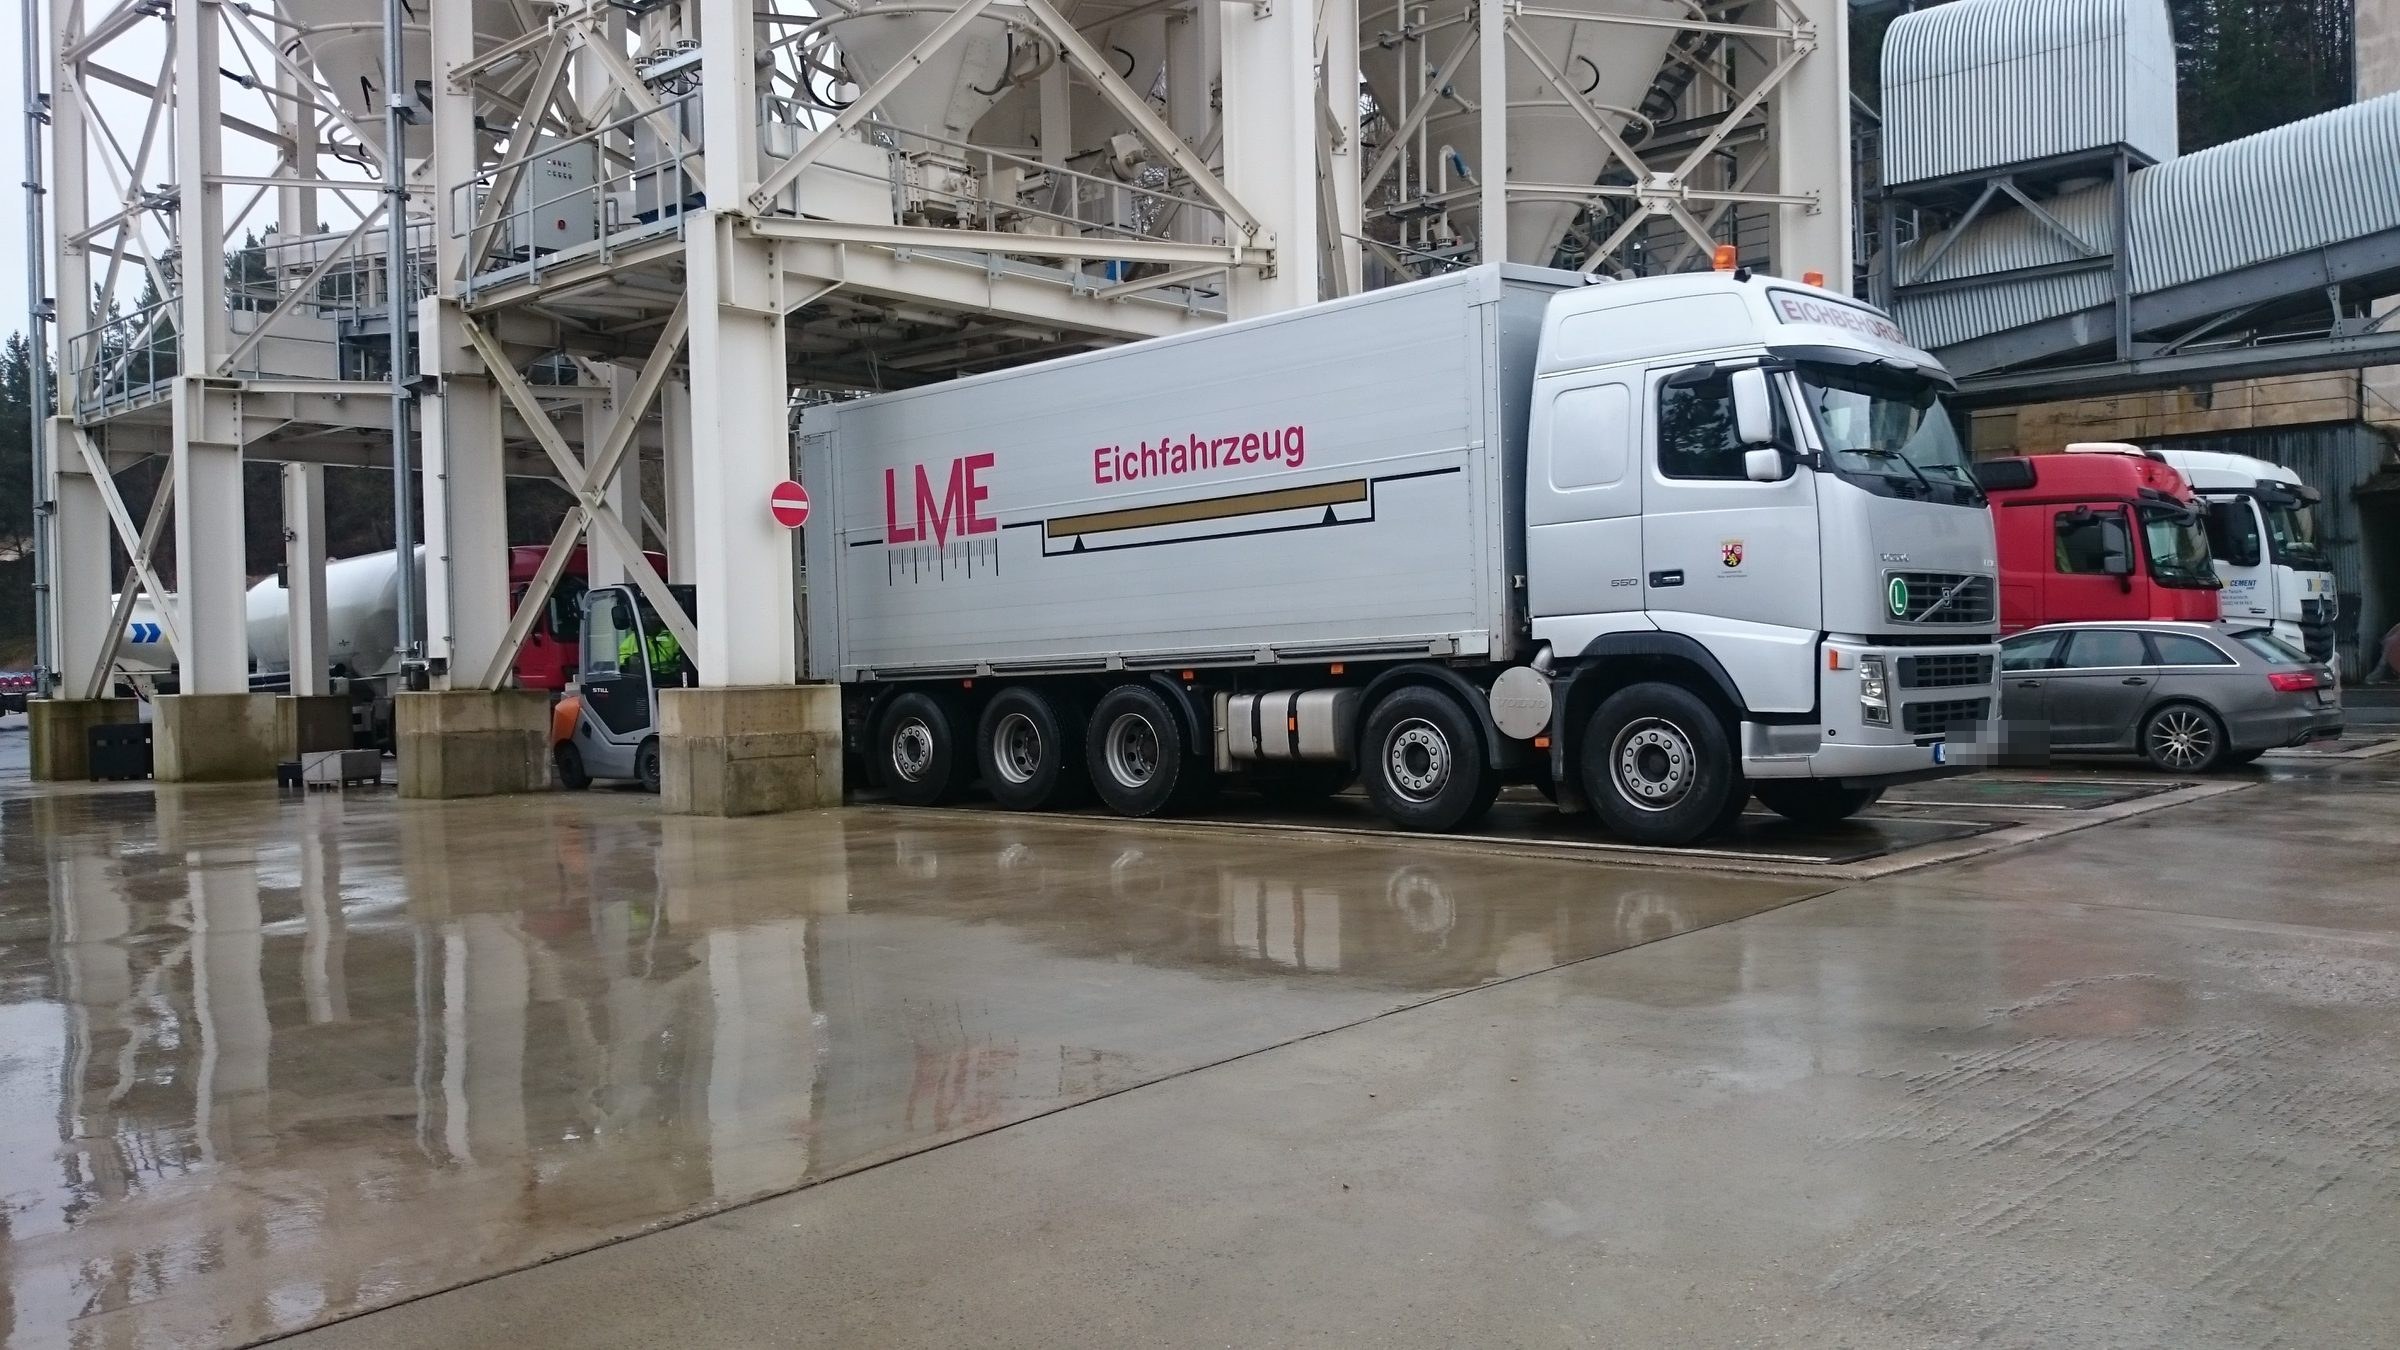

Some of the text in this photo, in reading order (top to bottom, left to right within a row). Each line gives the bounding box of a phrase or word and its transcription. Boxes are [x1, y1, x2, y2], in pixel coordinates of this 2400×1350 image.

[1094, 425, 1304, 485] Eichfahrzeug
[885, 452, 998, 550] LME
[1611, 578, 1638, 587] 550
[2230, 579, 2257, 587] CEMENT
[1894, 585, 1903, 608] L
